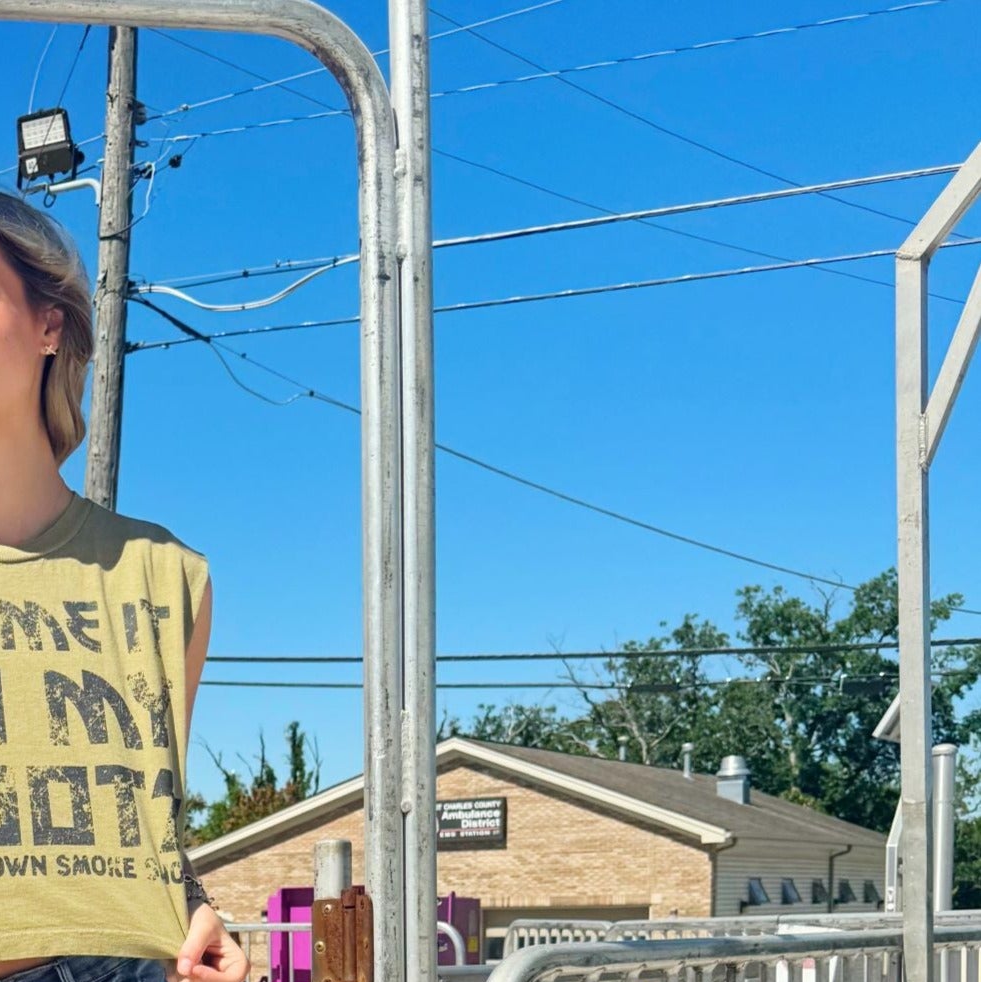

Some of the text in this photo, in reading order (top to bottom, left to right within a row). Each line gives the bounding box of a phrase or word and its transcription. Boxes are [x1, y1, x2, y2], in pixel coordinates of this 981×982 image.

[122, 598, 171, 657] IT
[44, 670, 173, 751] MY
[474, 800, 501, 809] COUNTY
[441, 810, 501, 820] Ambulance
[461, 819, 501, 828] District
[56, 854, 137, 879] SMOKE
